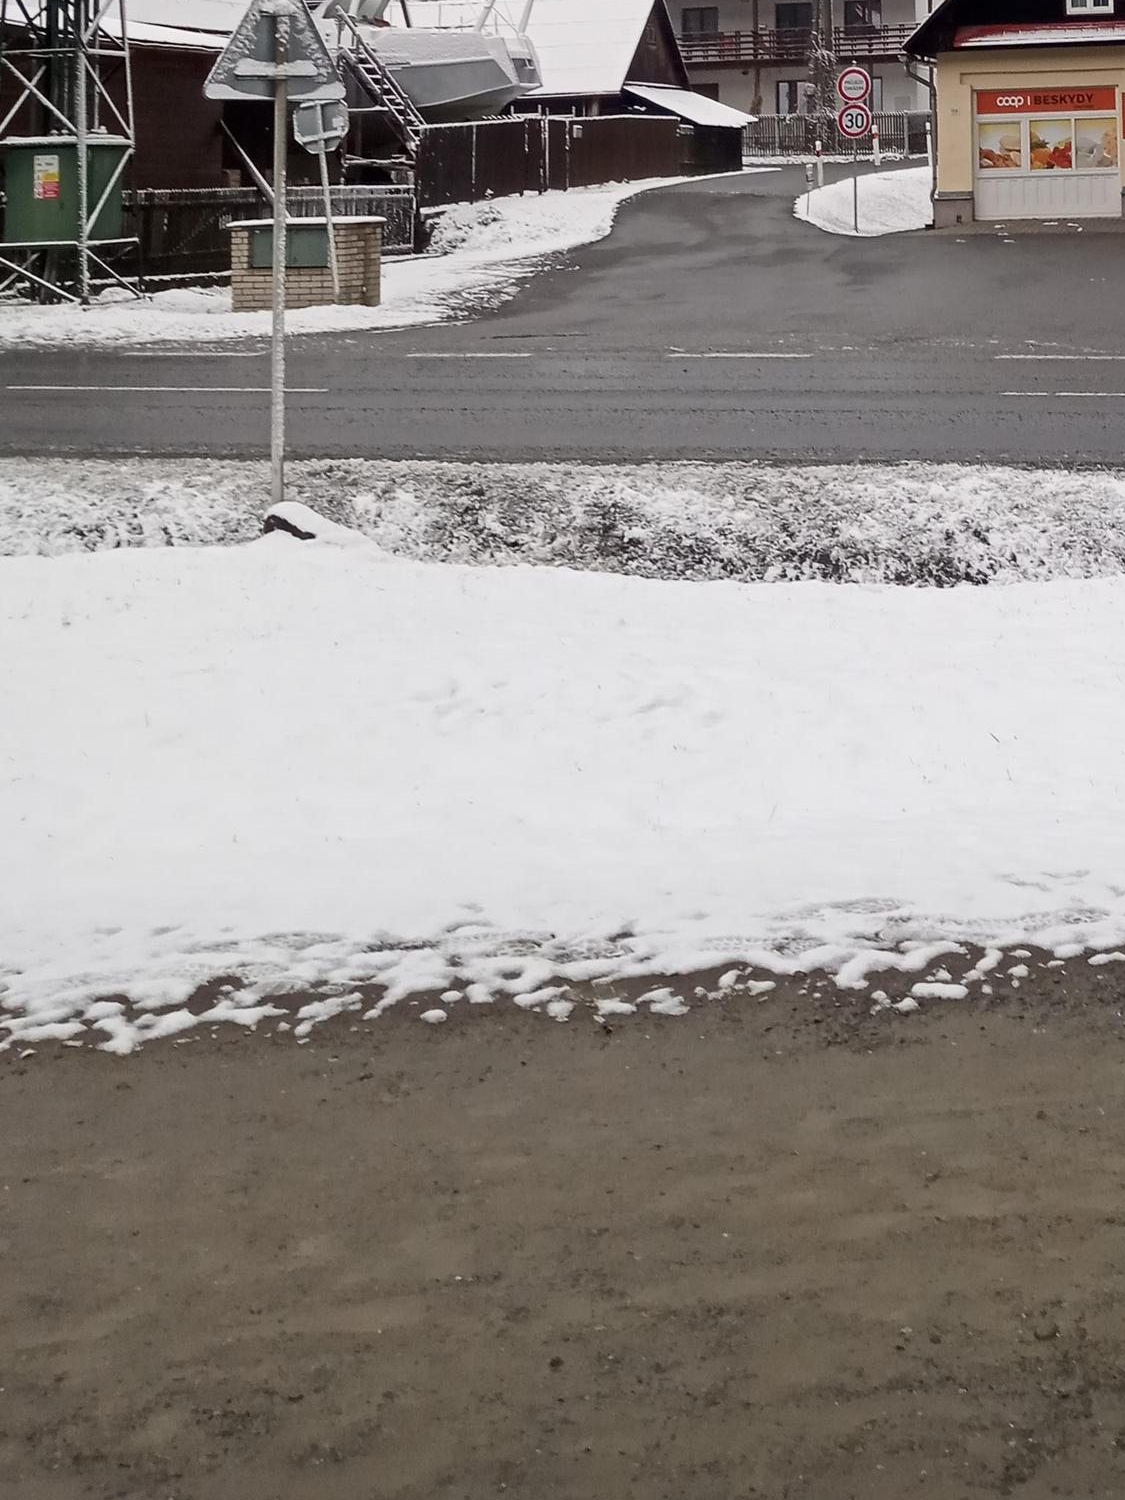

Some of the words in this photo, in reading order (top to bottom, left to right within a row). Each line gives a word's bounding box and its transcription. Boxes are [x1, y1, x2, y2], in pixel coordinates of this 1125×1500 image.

[996, 96, 1024, 108] coop
[1034, 94, 1094, 105] BESKYDY
[845, 113, 864, 129] 30
